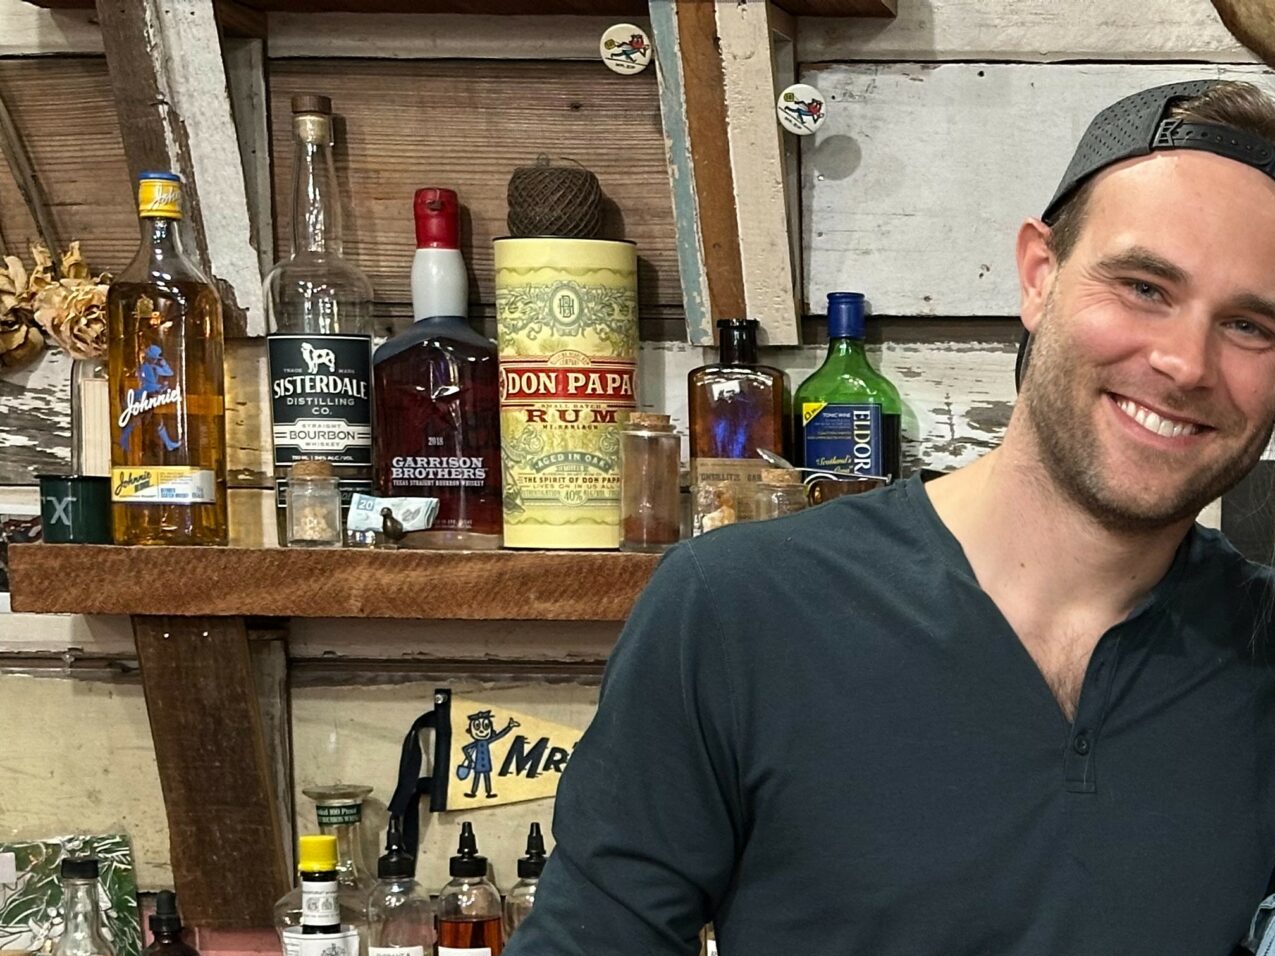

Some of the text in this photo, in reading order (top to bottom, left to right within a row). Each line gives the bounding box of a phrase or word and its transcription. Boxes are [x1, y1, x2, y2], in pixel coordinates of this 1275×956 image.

[273, 375, 367, 399] SISTERDALE
[508, 372, 632, 395] DON PAPA
[118, 388, 181, 427] Johnnie
[286, 397, 355, 406] DISTILLING
[311, 407, 333, 415] CO.
[525, 409, 618, 423] RUM
[289, 430, 356, 441] BOURBON
[853, 410, 872, 475] ELDOR
[392, 457, 484, 468] GARRISON
[538, 454, 565, 468] AGED
[391, 467, 486, 479] BROTHERS
[358, 500, 374, 510] 20
